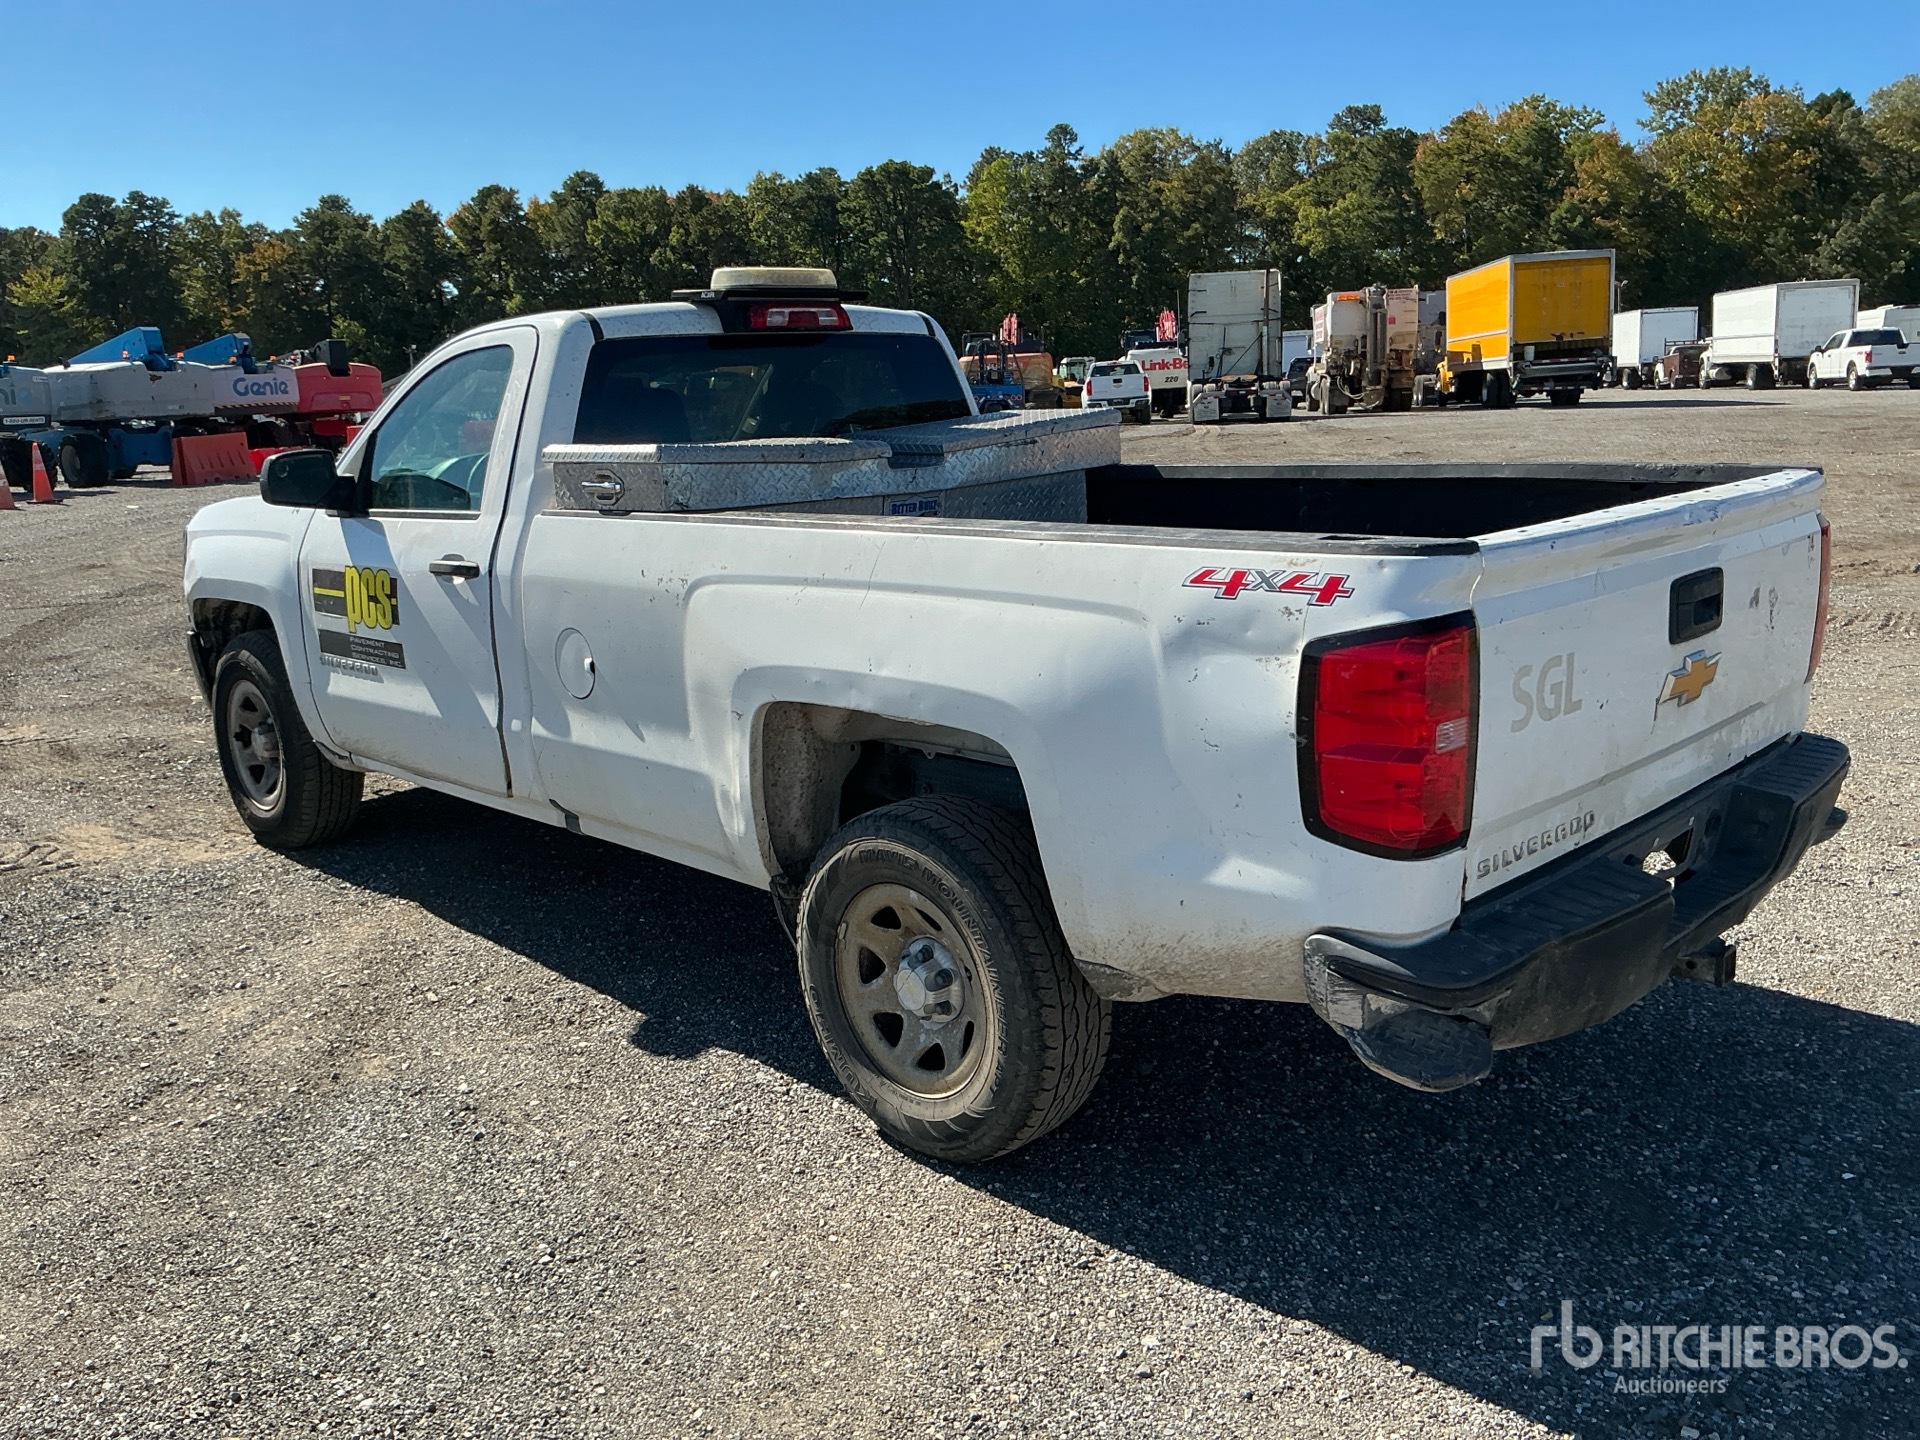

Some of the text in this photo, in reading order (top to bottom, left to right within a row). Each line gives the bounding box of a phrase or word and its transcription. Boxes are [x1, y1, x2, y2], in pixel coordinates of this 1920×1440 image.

[232, 376, 290, 397] Genie
[1164, 375, 1179, 383] 220
[891, 502, 917, 515] BETTER
[1510, 651, 1583, 733] SGL
[1476, 809, 1595, 880] SILVERADO
[858, 848, 919, 871] MAVIS
[921, 866, 1008, 1057] MOUNTAINEER
[809, 983, 877, 1111] KUMHO
